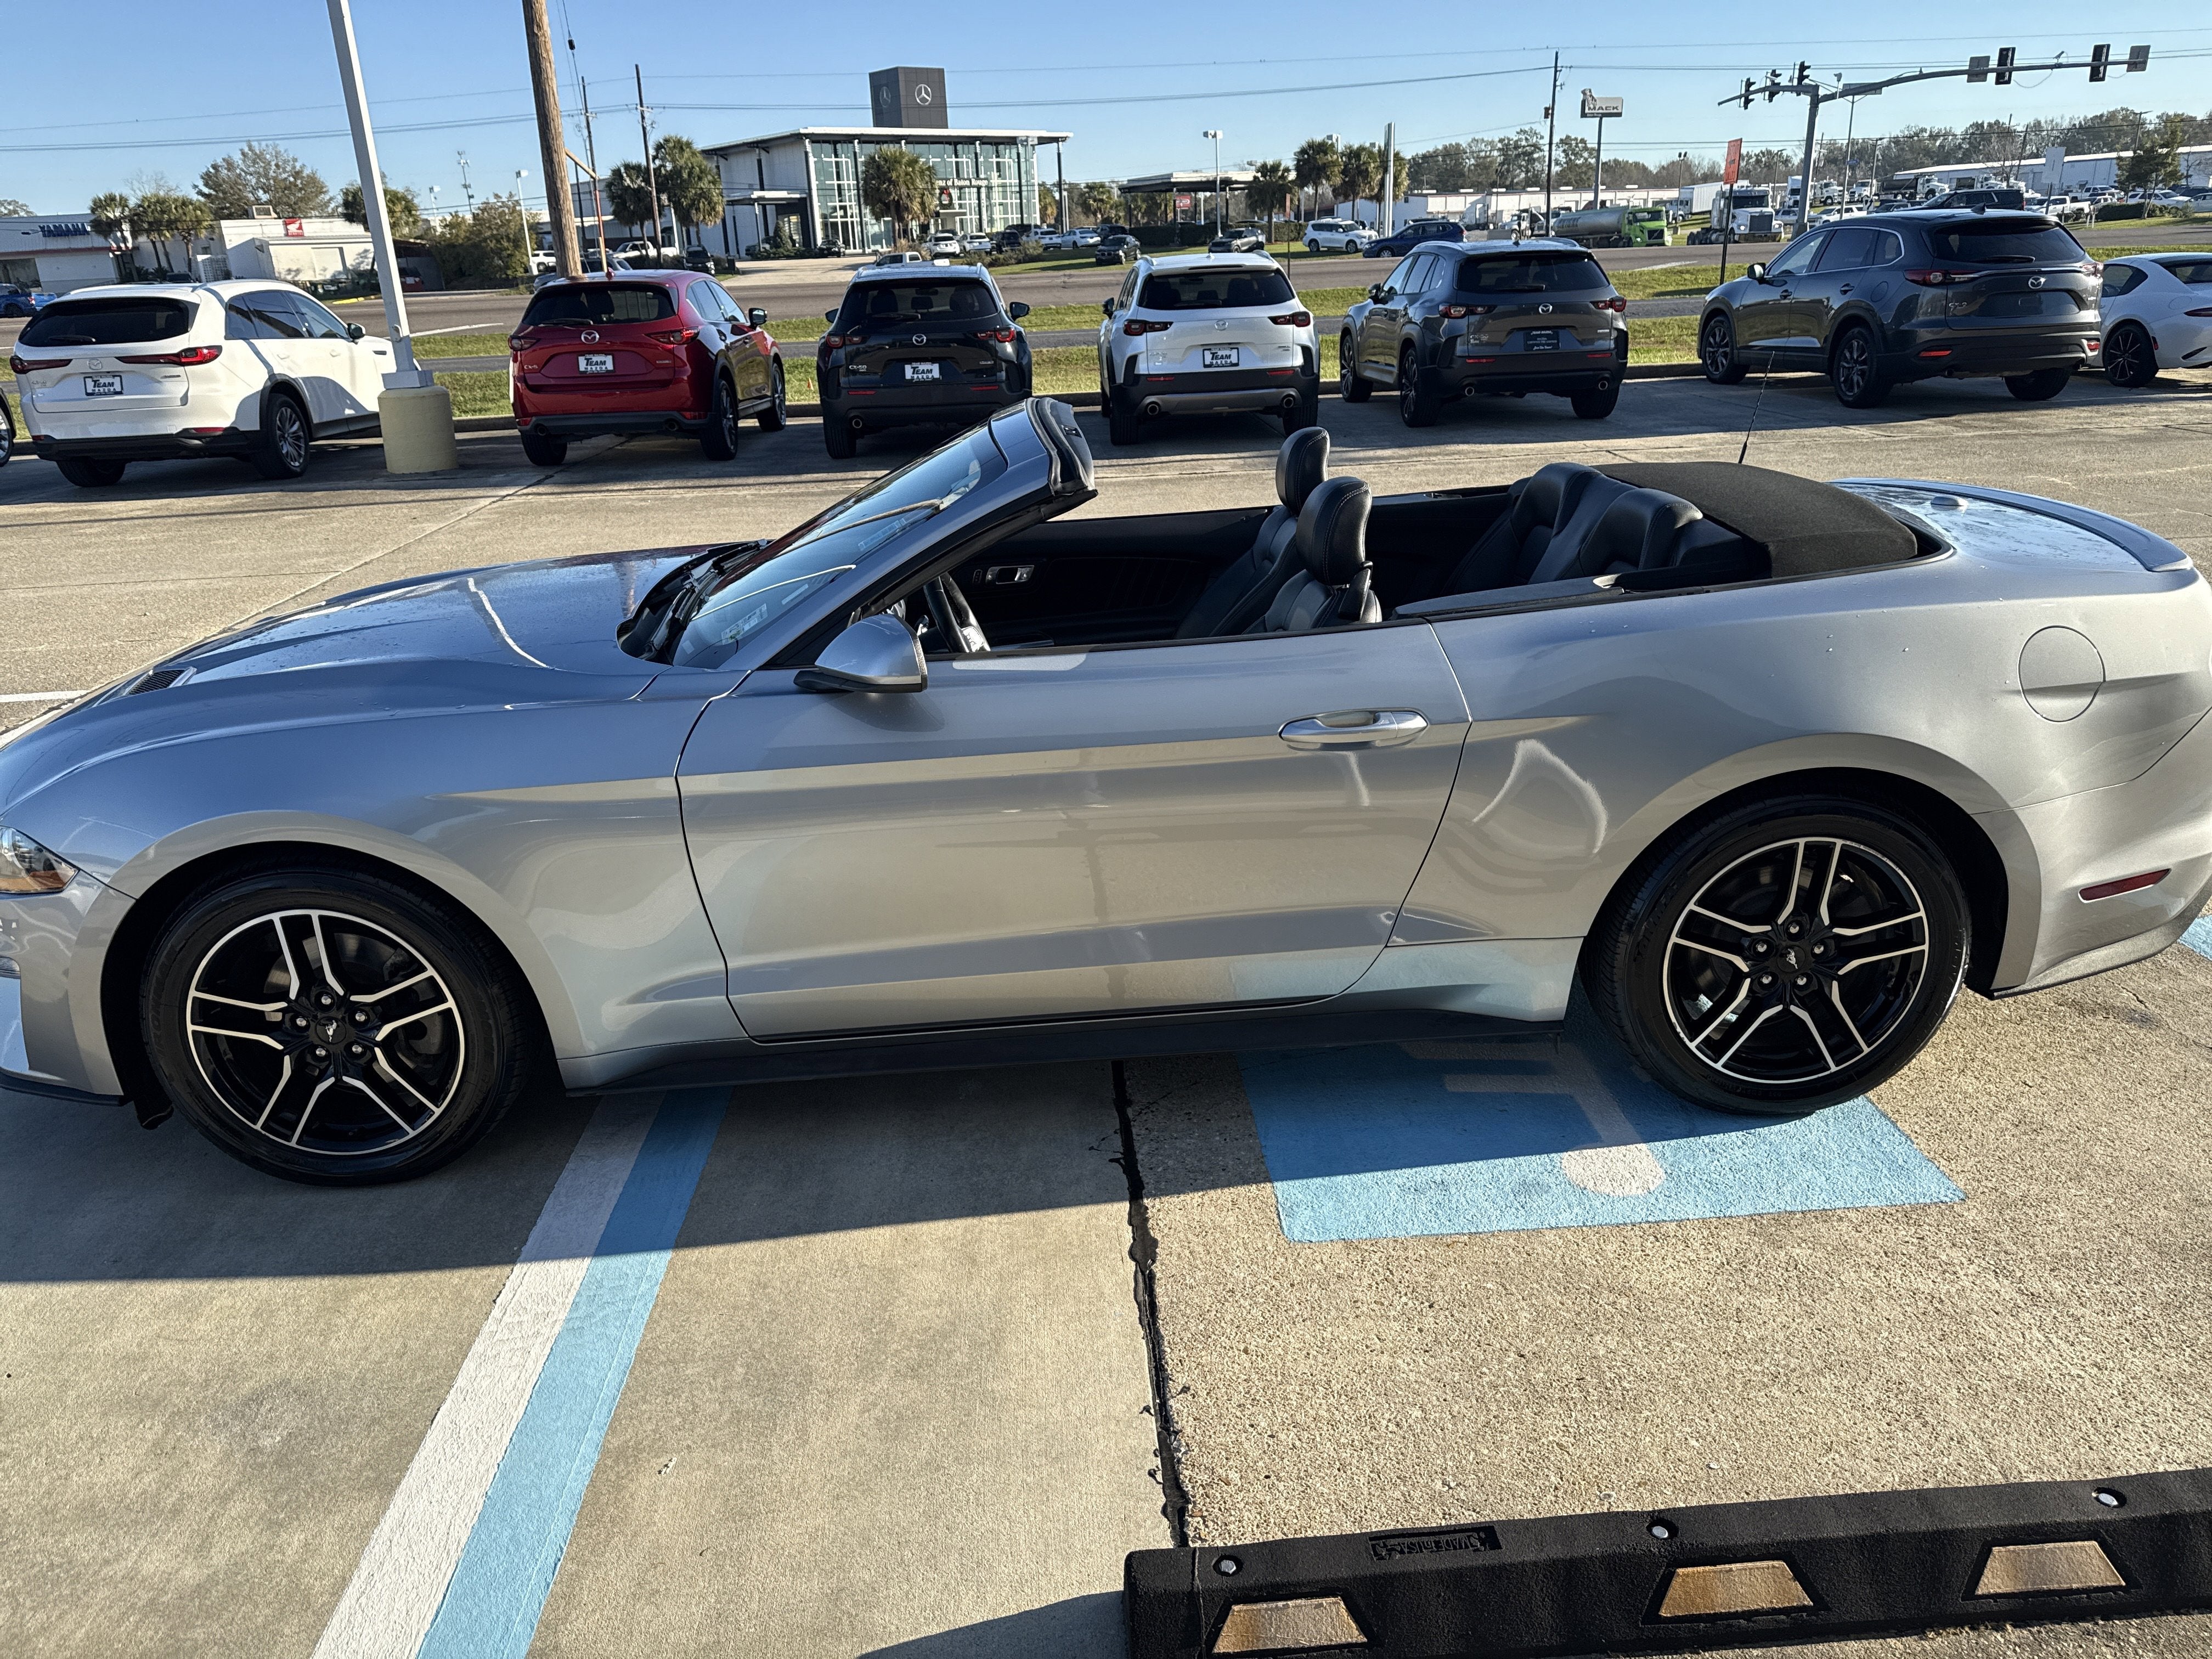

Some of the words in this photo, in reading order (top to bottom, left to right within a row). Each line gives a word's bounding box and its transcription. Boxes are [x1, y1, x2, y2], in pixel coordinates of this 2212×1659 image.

[947, 178, 953, 187] of
[971, 178, 988, 187] Rouge
[38, 223, 90, 238] YAMAHA
[584, 358, 606, 366] TEAM
[911, 366, 933, 375] TEAM
[92, 380, 114, 388] TEAM
